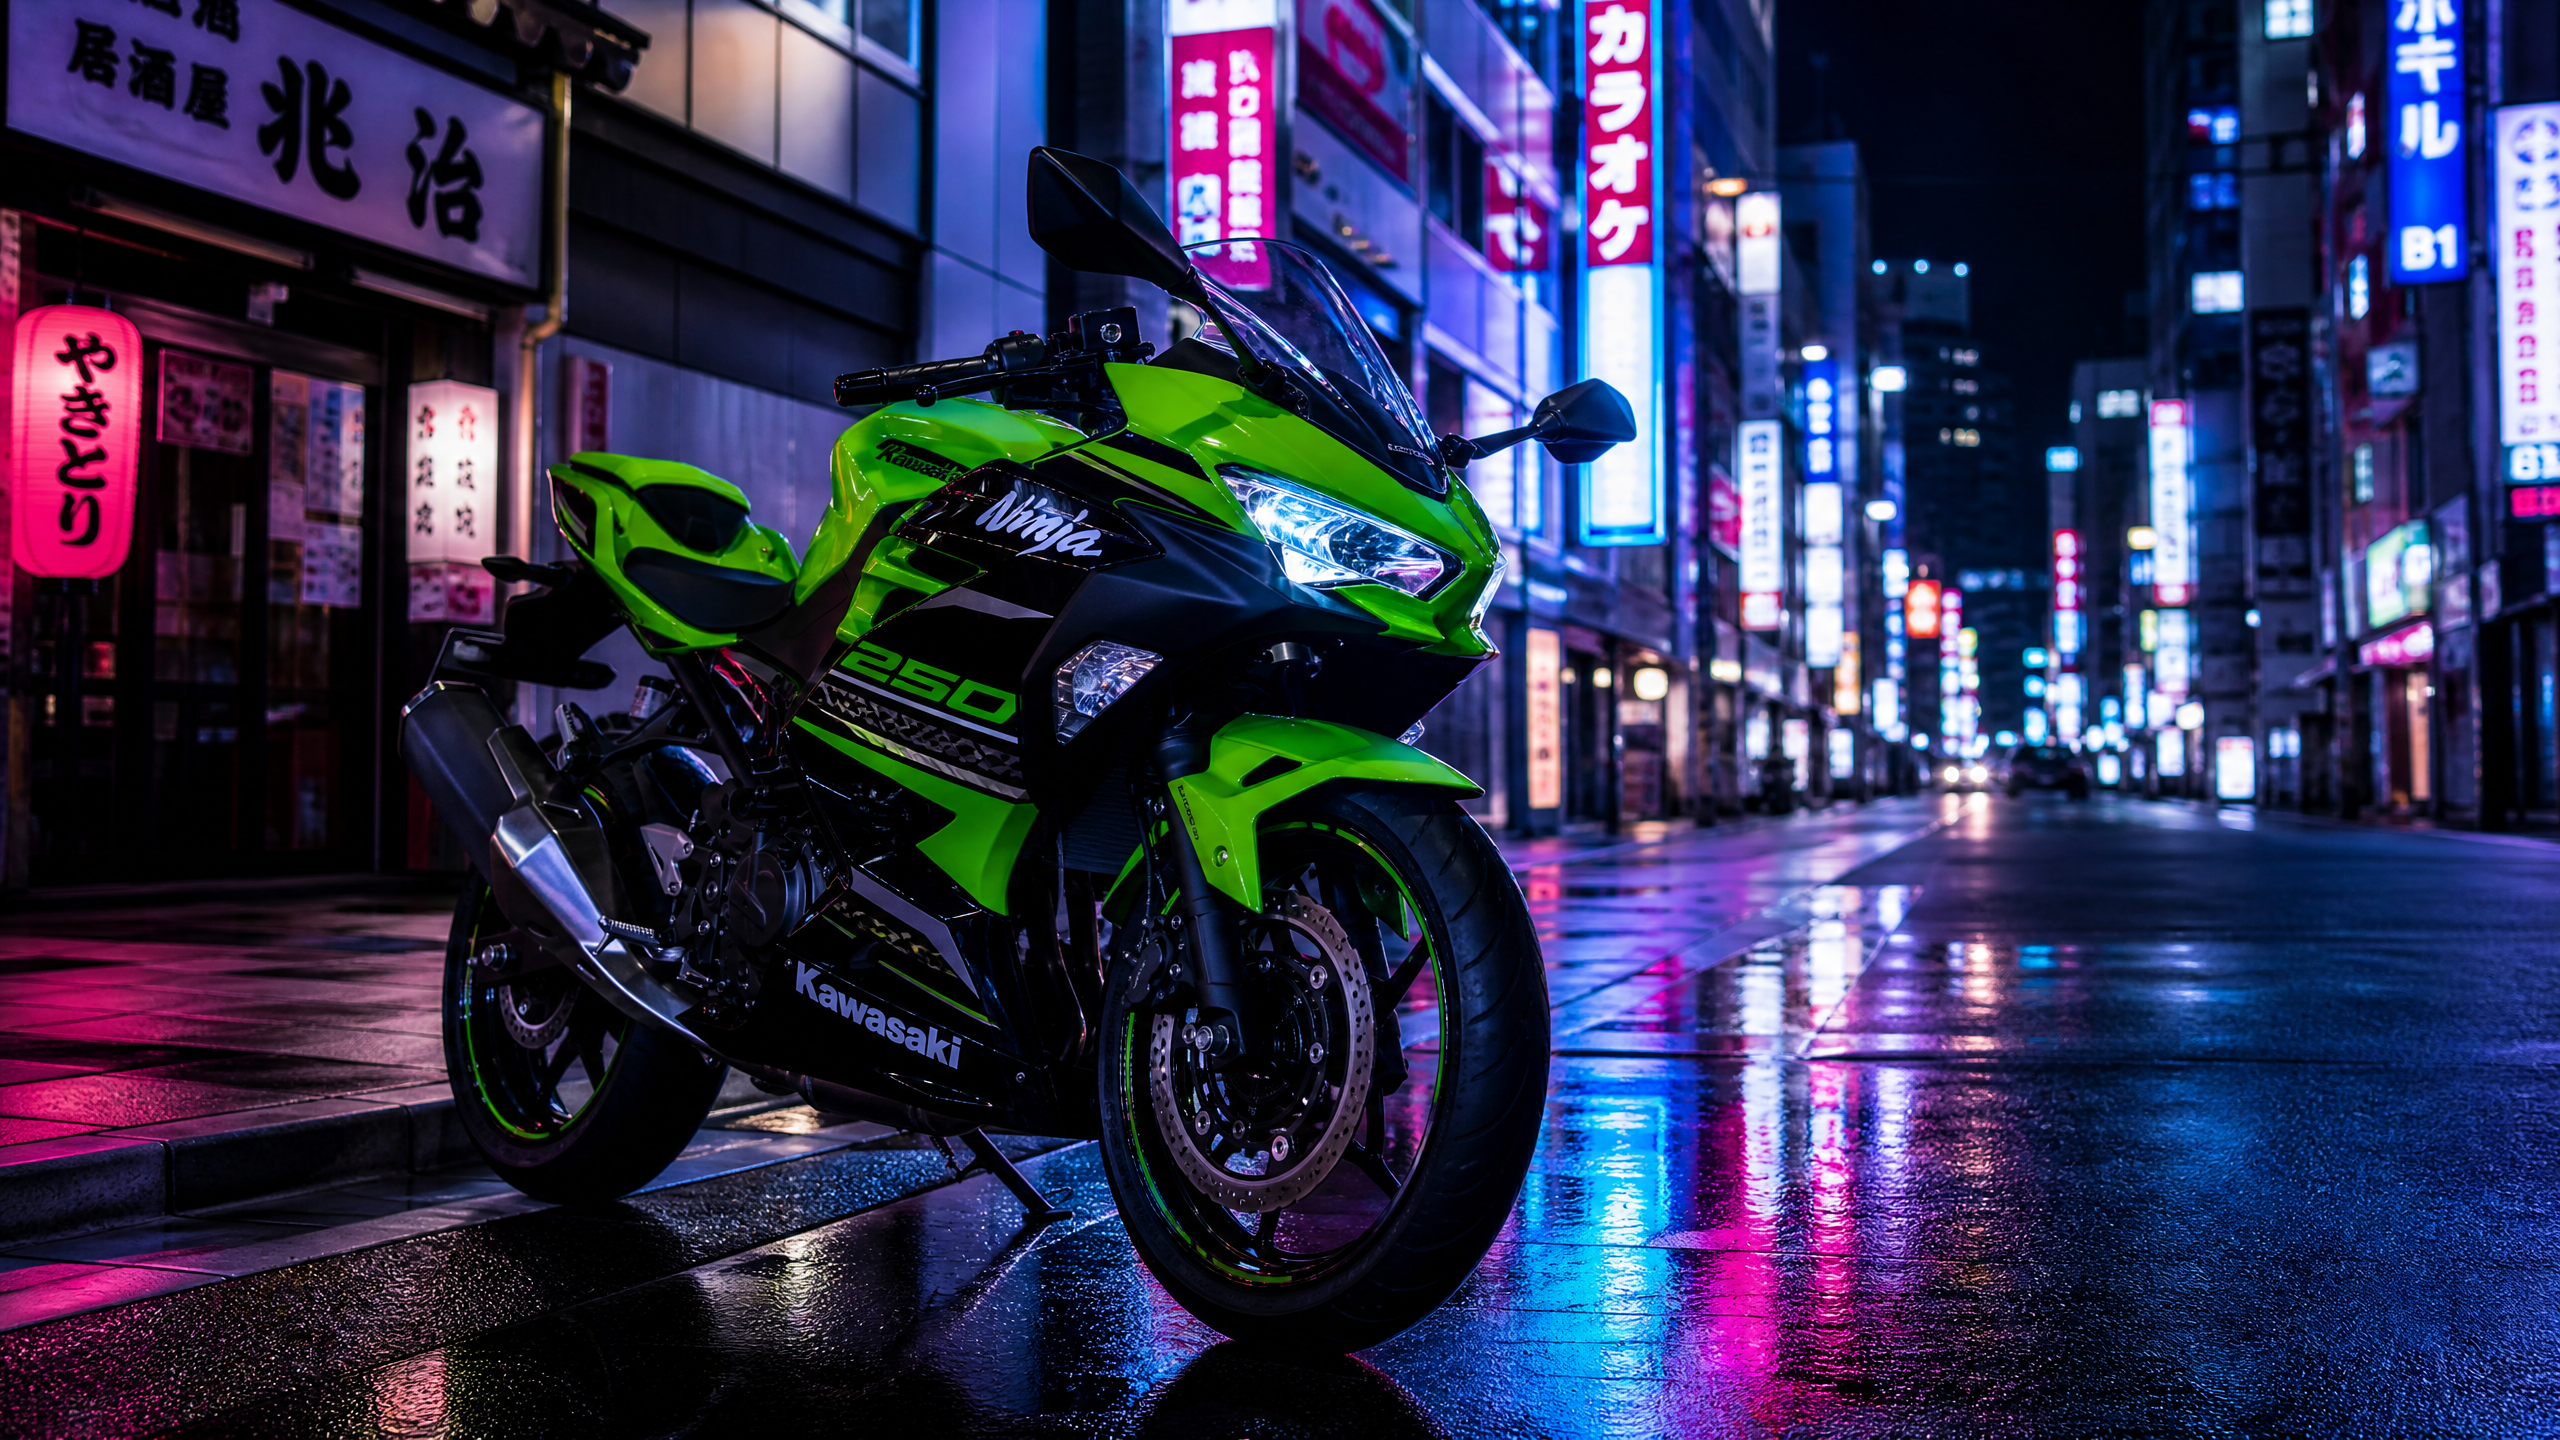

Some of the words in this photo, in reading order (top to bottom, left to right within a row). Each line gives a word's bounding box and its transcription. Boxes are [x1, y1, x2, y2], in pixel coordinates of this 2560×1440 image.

[67, 18, 231, 130] 居酒屋
[257, 56, 485, 243] 兆治
[1588, 4, 1649, 261] カラオケ
[2399, 223, 2458, 272] B1
[56, 333, 117, 547] やきとり
[974, 489, 1102, 557] Ninja
[840, 640, 1017, 725] 250
[796, 961, 963, 1070] Kawasaki
